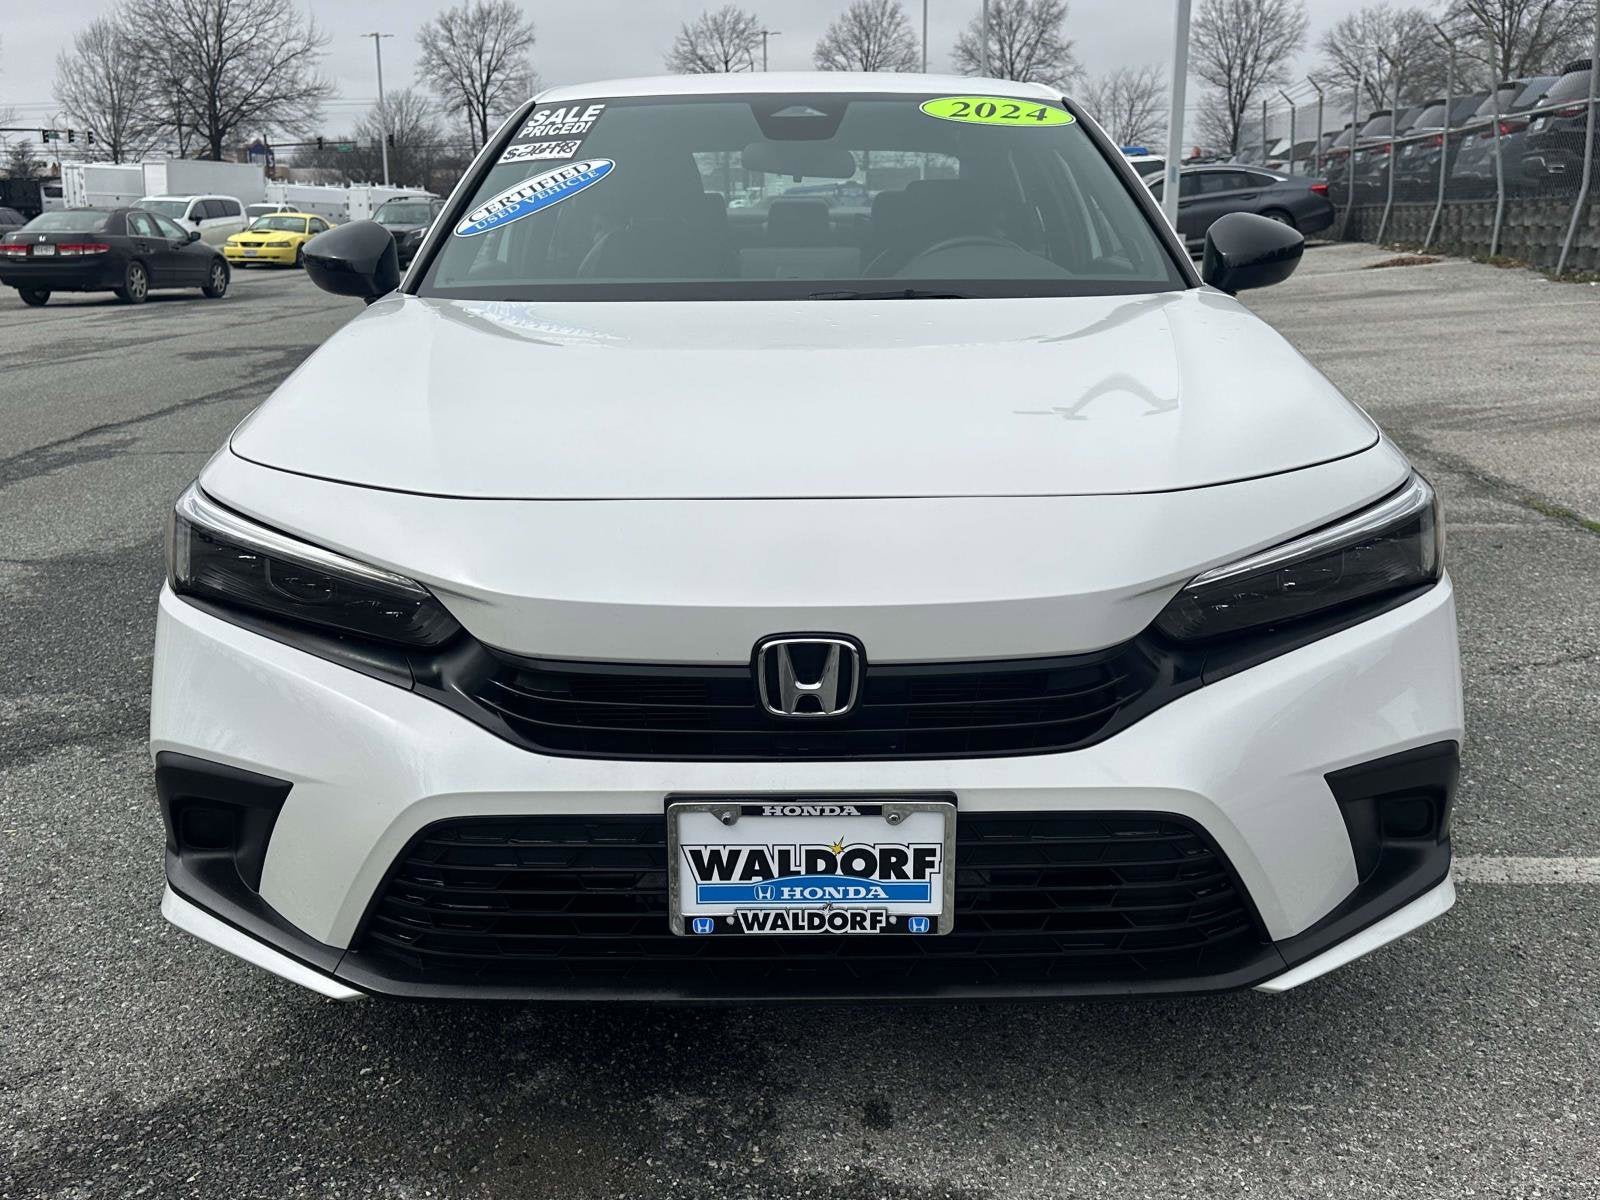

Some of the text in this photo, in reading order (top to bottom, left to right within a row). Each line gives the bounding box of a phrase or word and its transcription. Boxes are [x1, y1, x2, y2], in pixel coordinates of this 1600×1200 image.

[528, 104, 606, 127] SALE
[950, 101, 1047, 121] 2024
[518, 121, 593, 139] PRICED!
[469, 162, 592, 223] CERTIFIED
[474, 171, 600, 230] USED VEHICLE
[762, 805, 861, 816] HONDA
[686, 847, 938, 882] WALDORF
[780, 886, 889, 899] HONDA
[741, 911, 884, 932] WALDORF
